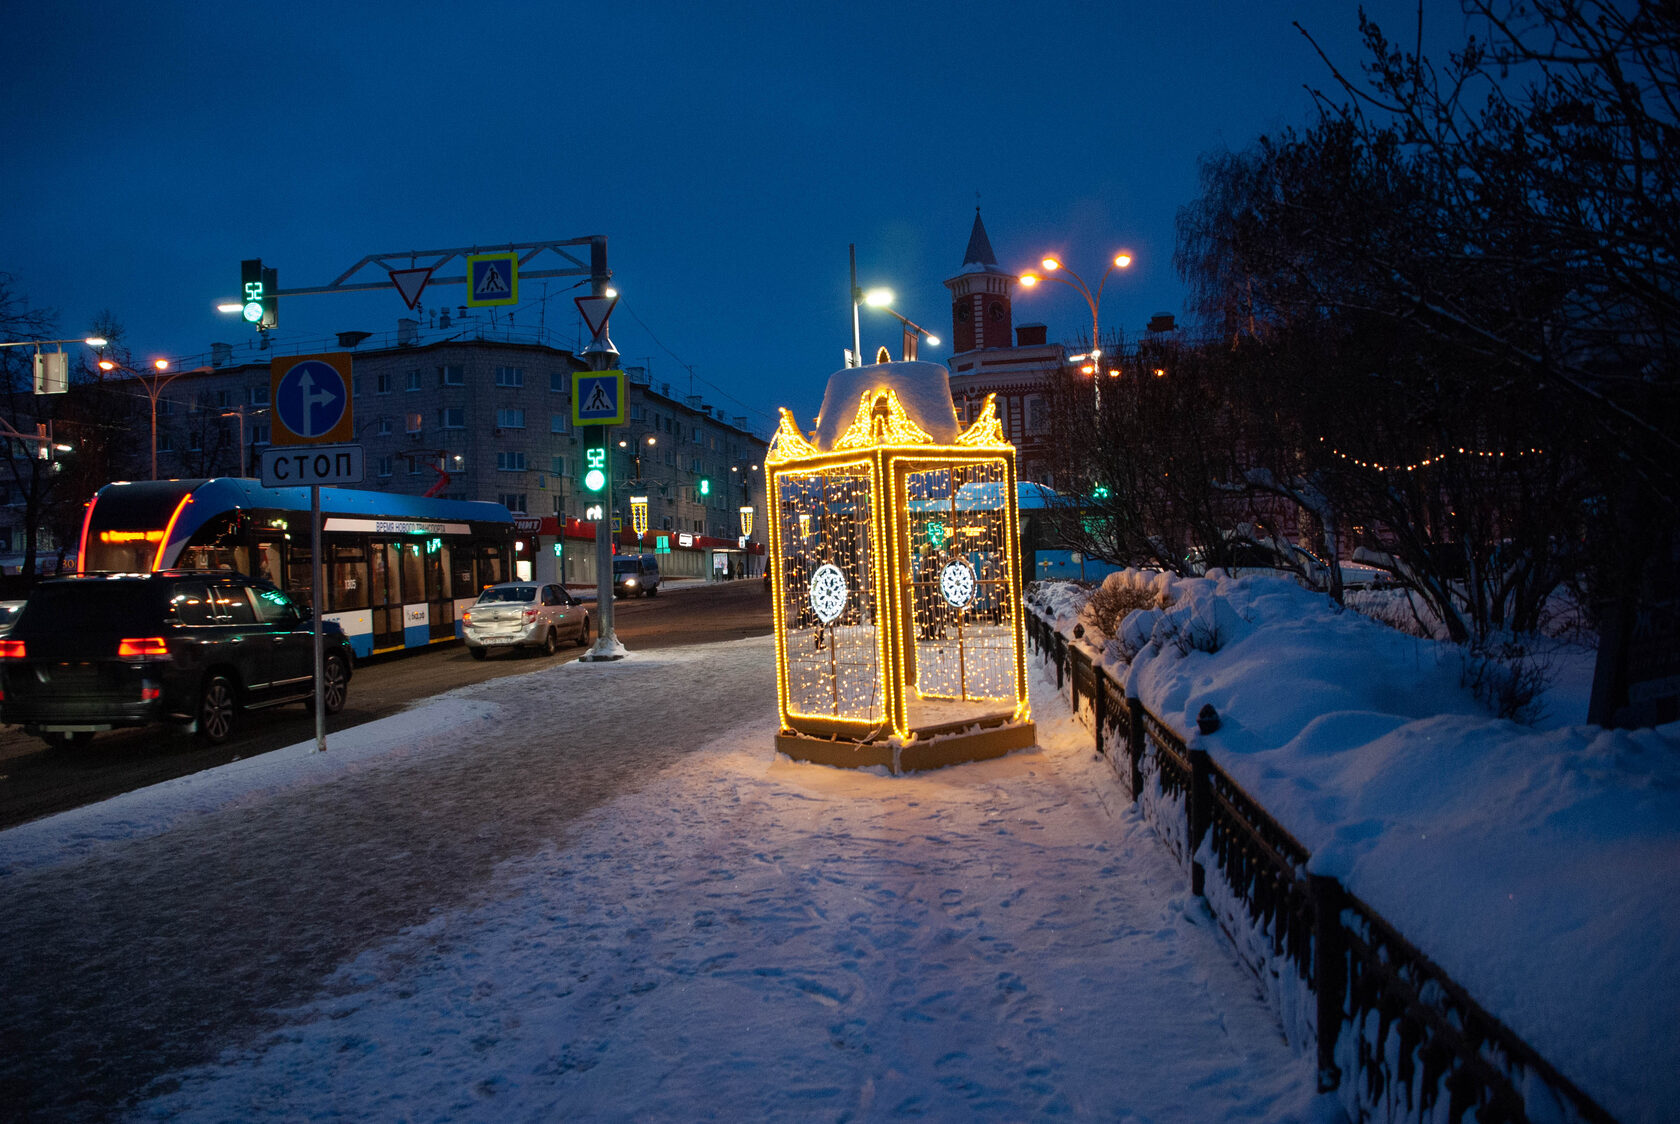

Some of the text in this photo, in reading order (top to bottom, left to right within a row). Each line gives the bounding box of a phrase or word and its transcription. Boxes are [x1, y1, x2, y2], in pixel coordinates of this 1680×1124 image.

[245, 282, 262, 300] 52
[273, 453, 352, 480] СТОП
[586, 448, 605, 468] 52
[375, 521, 394, 533] ВРЕМЯ
[395, 522, 414, 533] НОВОГО
